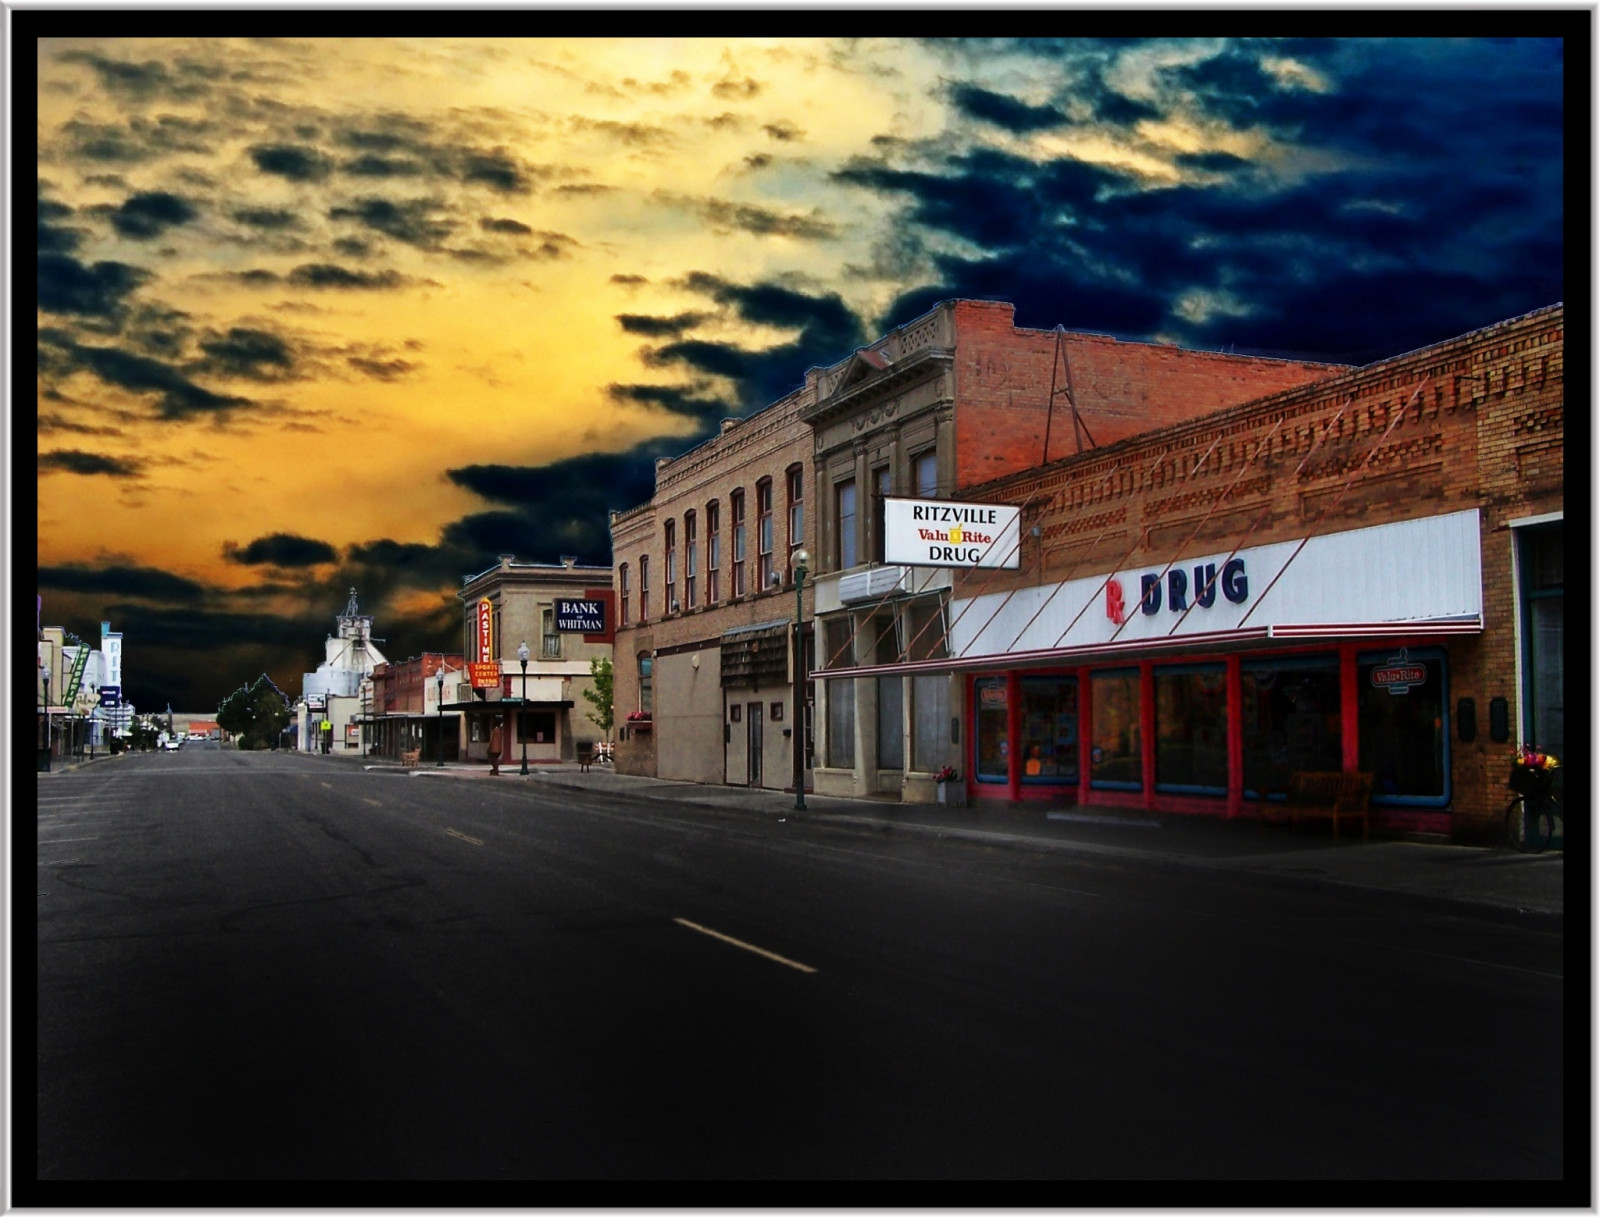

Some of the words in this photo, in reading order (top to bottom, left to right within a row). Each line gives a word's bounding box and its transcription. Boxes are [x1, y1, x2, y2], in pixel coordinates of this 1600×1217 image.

[913, 505, 996, 524] RITZVILLE
[918, 528, 948, 541] Valu
[961, 531, 992, 543] Rite
[929, 546, 980, 562] DRUG
[1141, 558, 1248, 616] DRUG
[561, 602, 599, 614] BANK
[558, 619, 602, 629] WHITMAN
[481, 603, 490, 663] PASTIME
[1376, 671, 1397, 682] Valu
[1399, 670, 1421, 681] Rite
